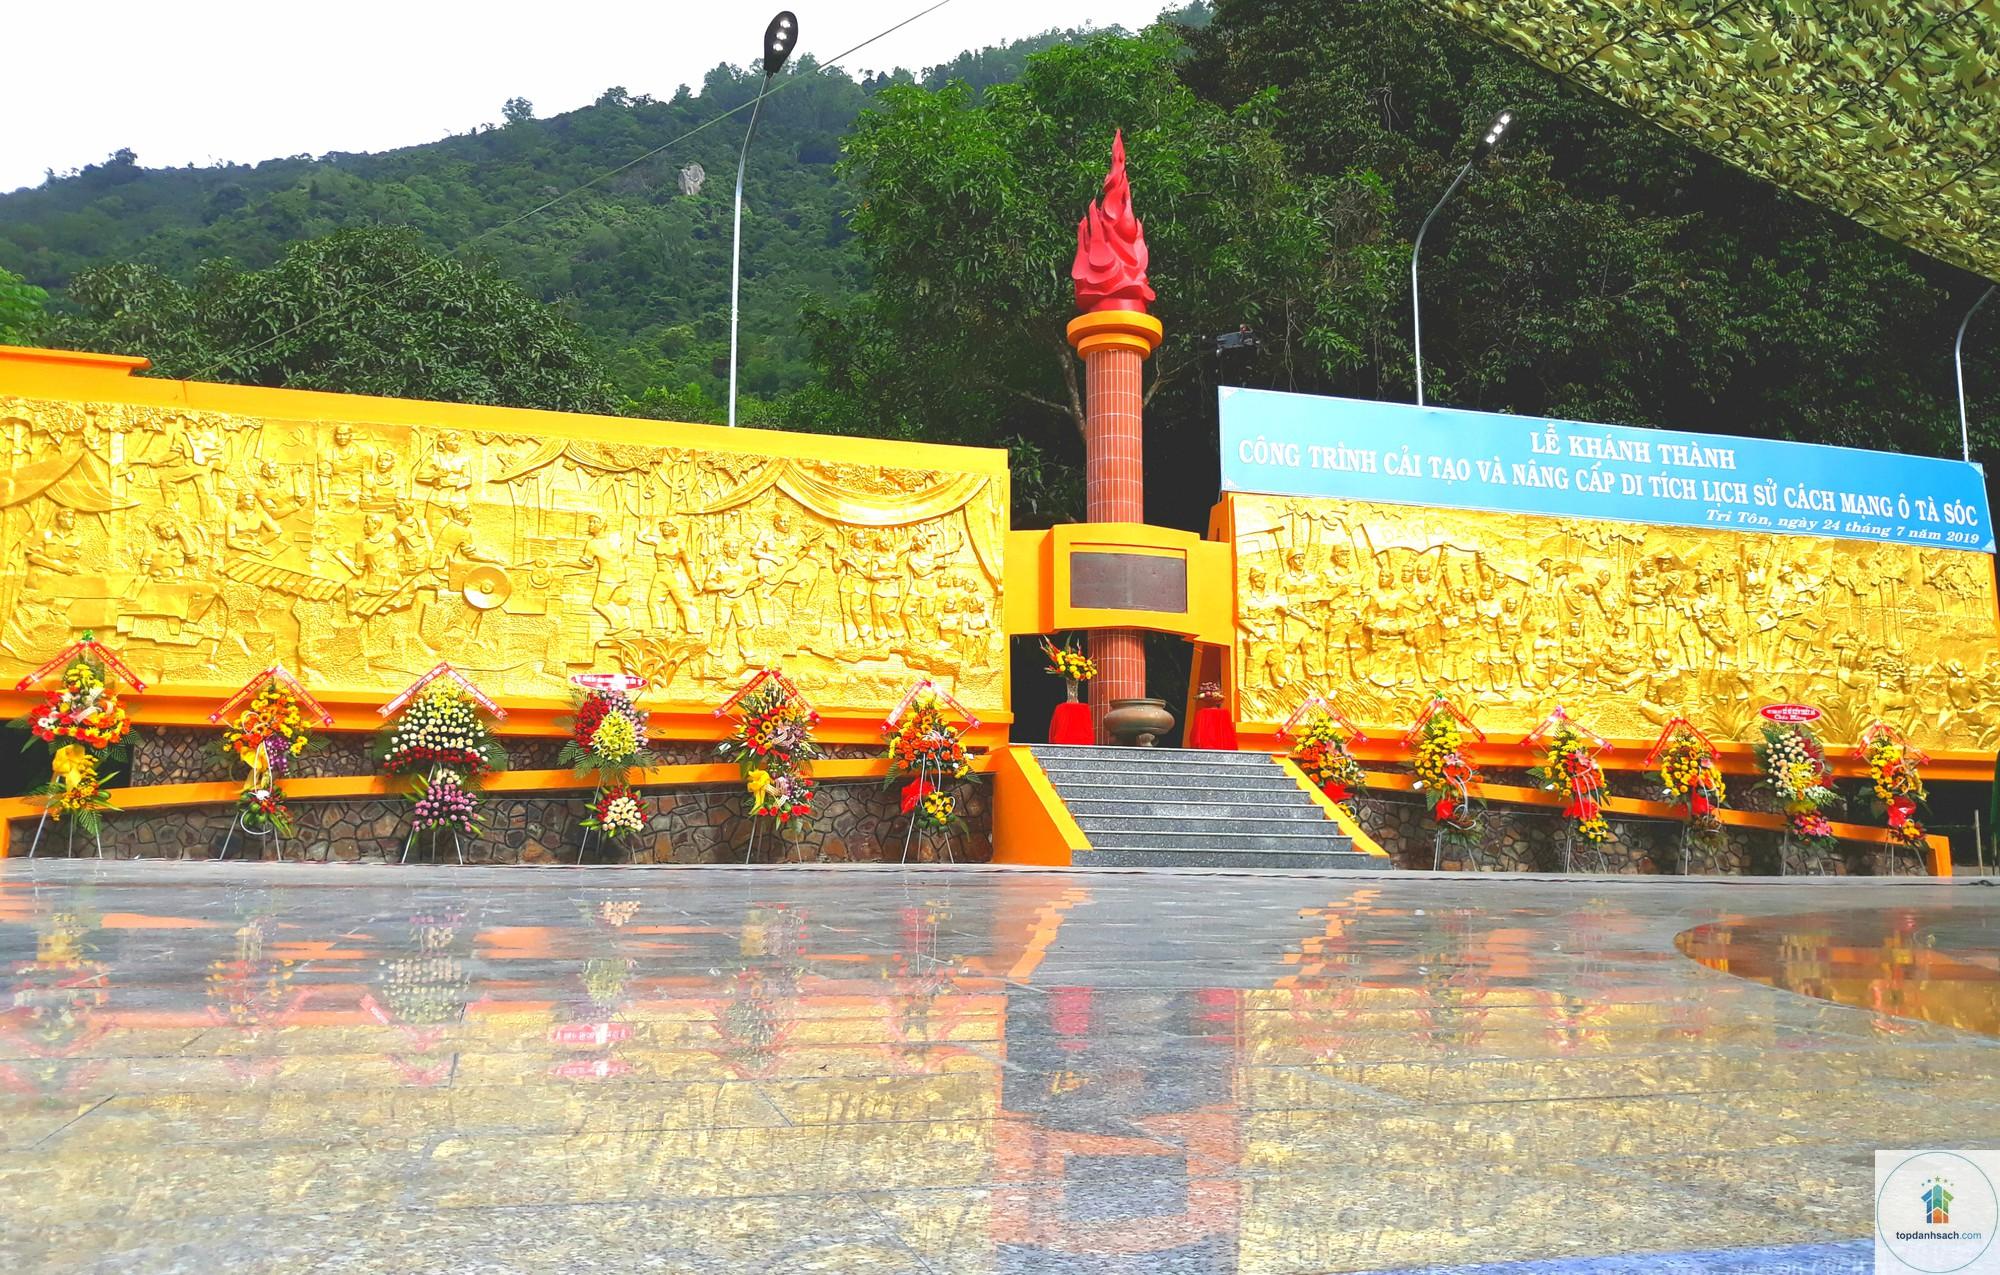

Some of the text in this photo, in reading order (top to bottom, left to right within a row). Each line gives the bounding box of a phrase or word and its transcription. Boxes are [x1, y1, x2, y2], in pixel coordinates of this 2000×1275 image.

[1530, 422, 1736, 470] LỄ KHÁNH THÀNH
[1238, 435, 1978, 527] CÔNG TRÌNH CẢI TẠO VÀ NÂNG CẤP DI TÍCH LỊCH SỬ CÁCH MẠNG Ô TÀ SÓC
[1706, 509, 1980, 544] Tri Tôn, ngày 24 tháng 7 năm 2019
